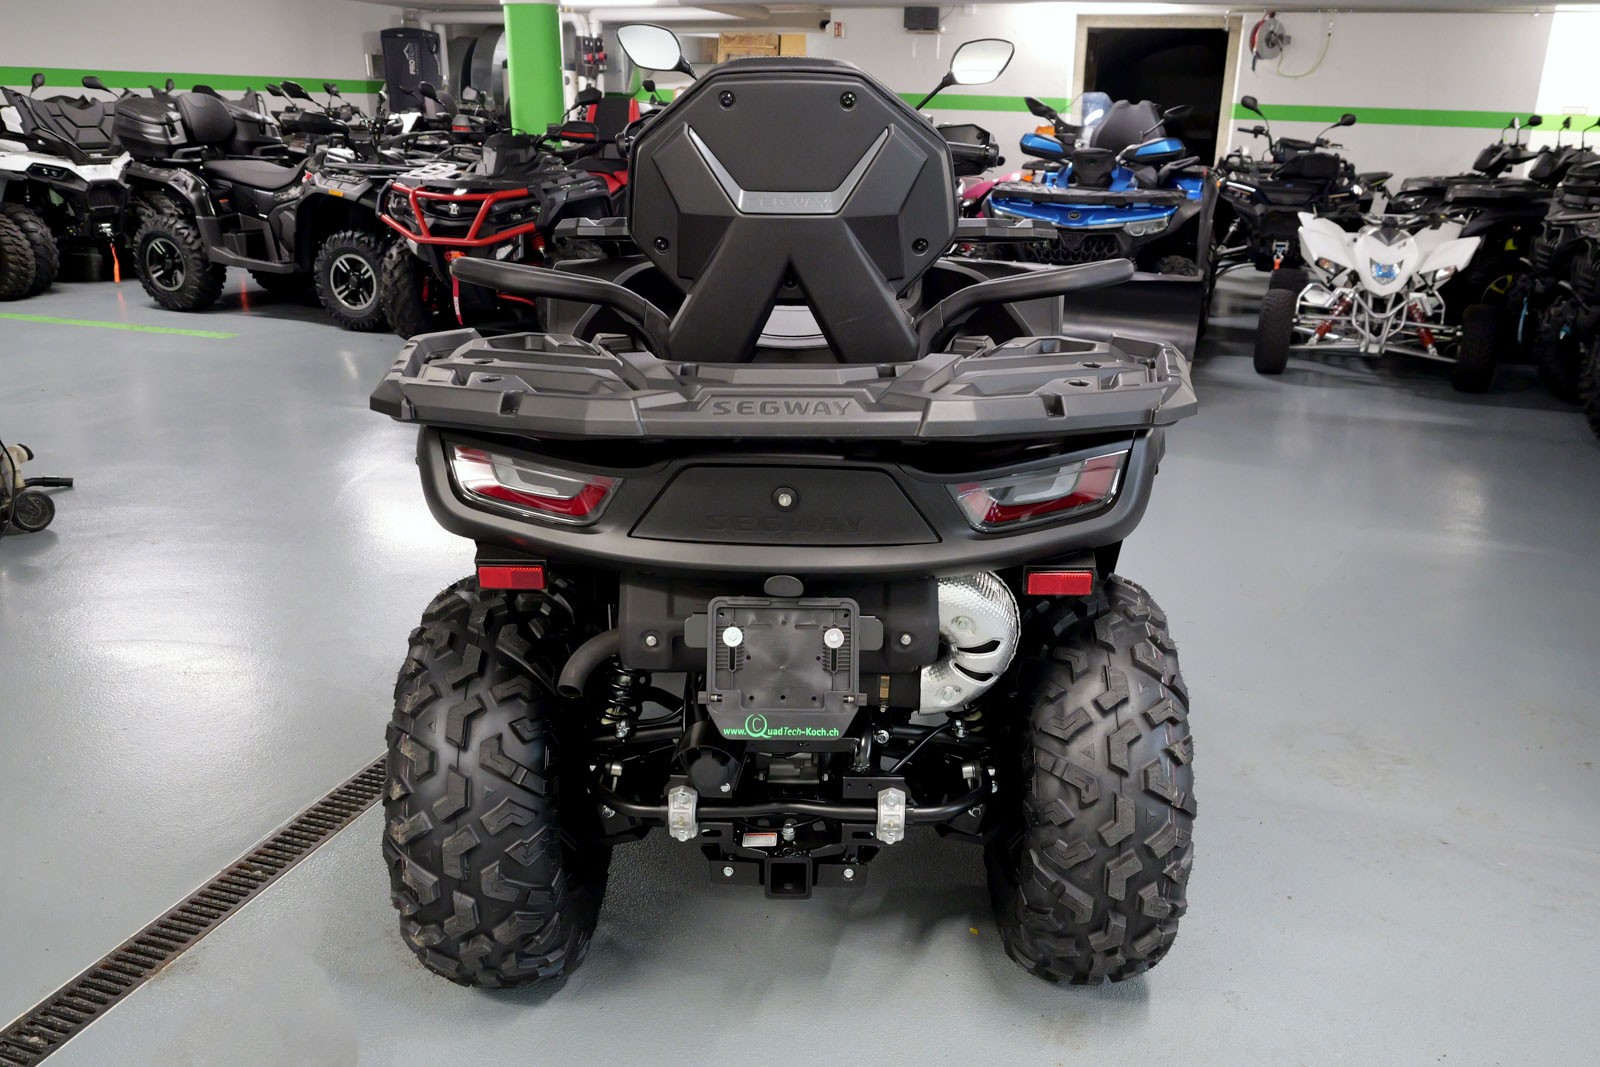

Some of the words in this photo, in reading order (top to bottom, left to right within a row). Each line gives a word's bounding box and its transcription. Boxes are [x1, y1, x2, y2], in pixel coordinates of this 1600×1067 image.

[711, 400, 851, 416] SEGWAY
[703, 514, 867, 535] SEGWAY
[723, 713, 839, 738] www.QuadTech-Koch.ch
